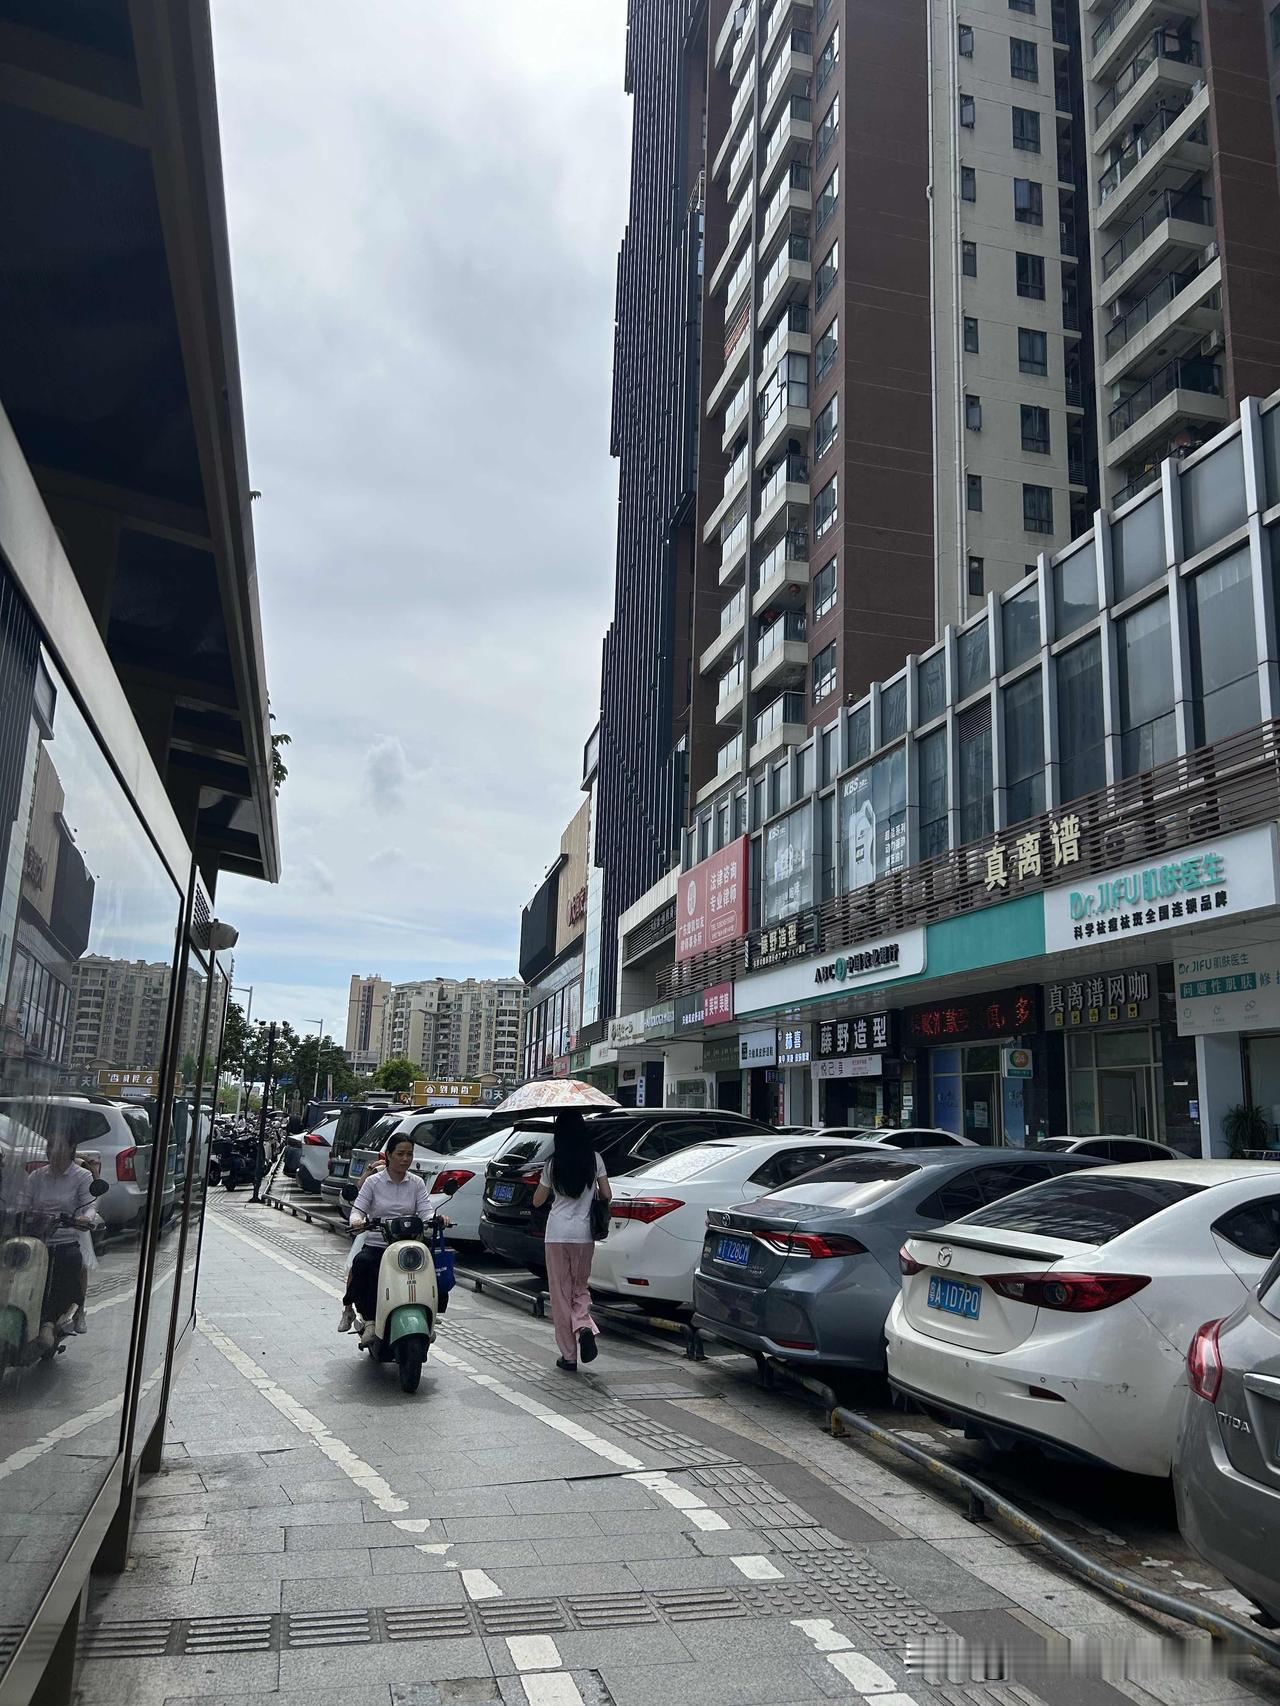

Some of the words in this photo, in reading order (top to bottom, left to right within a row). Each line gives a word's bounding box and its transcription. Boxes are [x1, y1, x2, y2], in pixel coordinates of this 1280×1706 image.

[844, 777, 859, 797] KBS
[984, 814, 1081, 892] 真离谱
[710, 861, 737, 891] 法律咨询
[710, 883, 737, 912] 专业律师
[814, 964, 836, 983] ABC
[847, 943, 900, 973] 中国农业银行
[1048, 971, 1149, 1015] 真离谱网咖
[820, 1015, 887, 1054] 藤野造型
